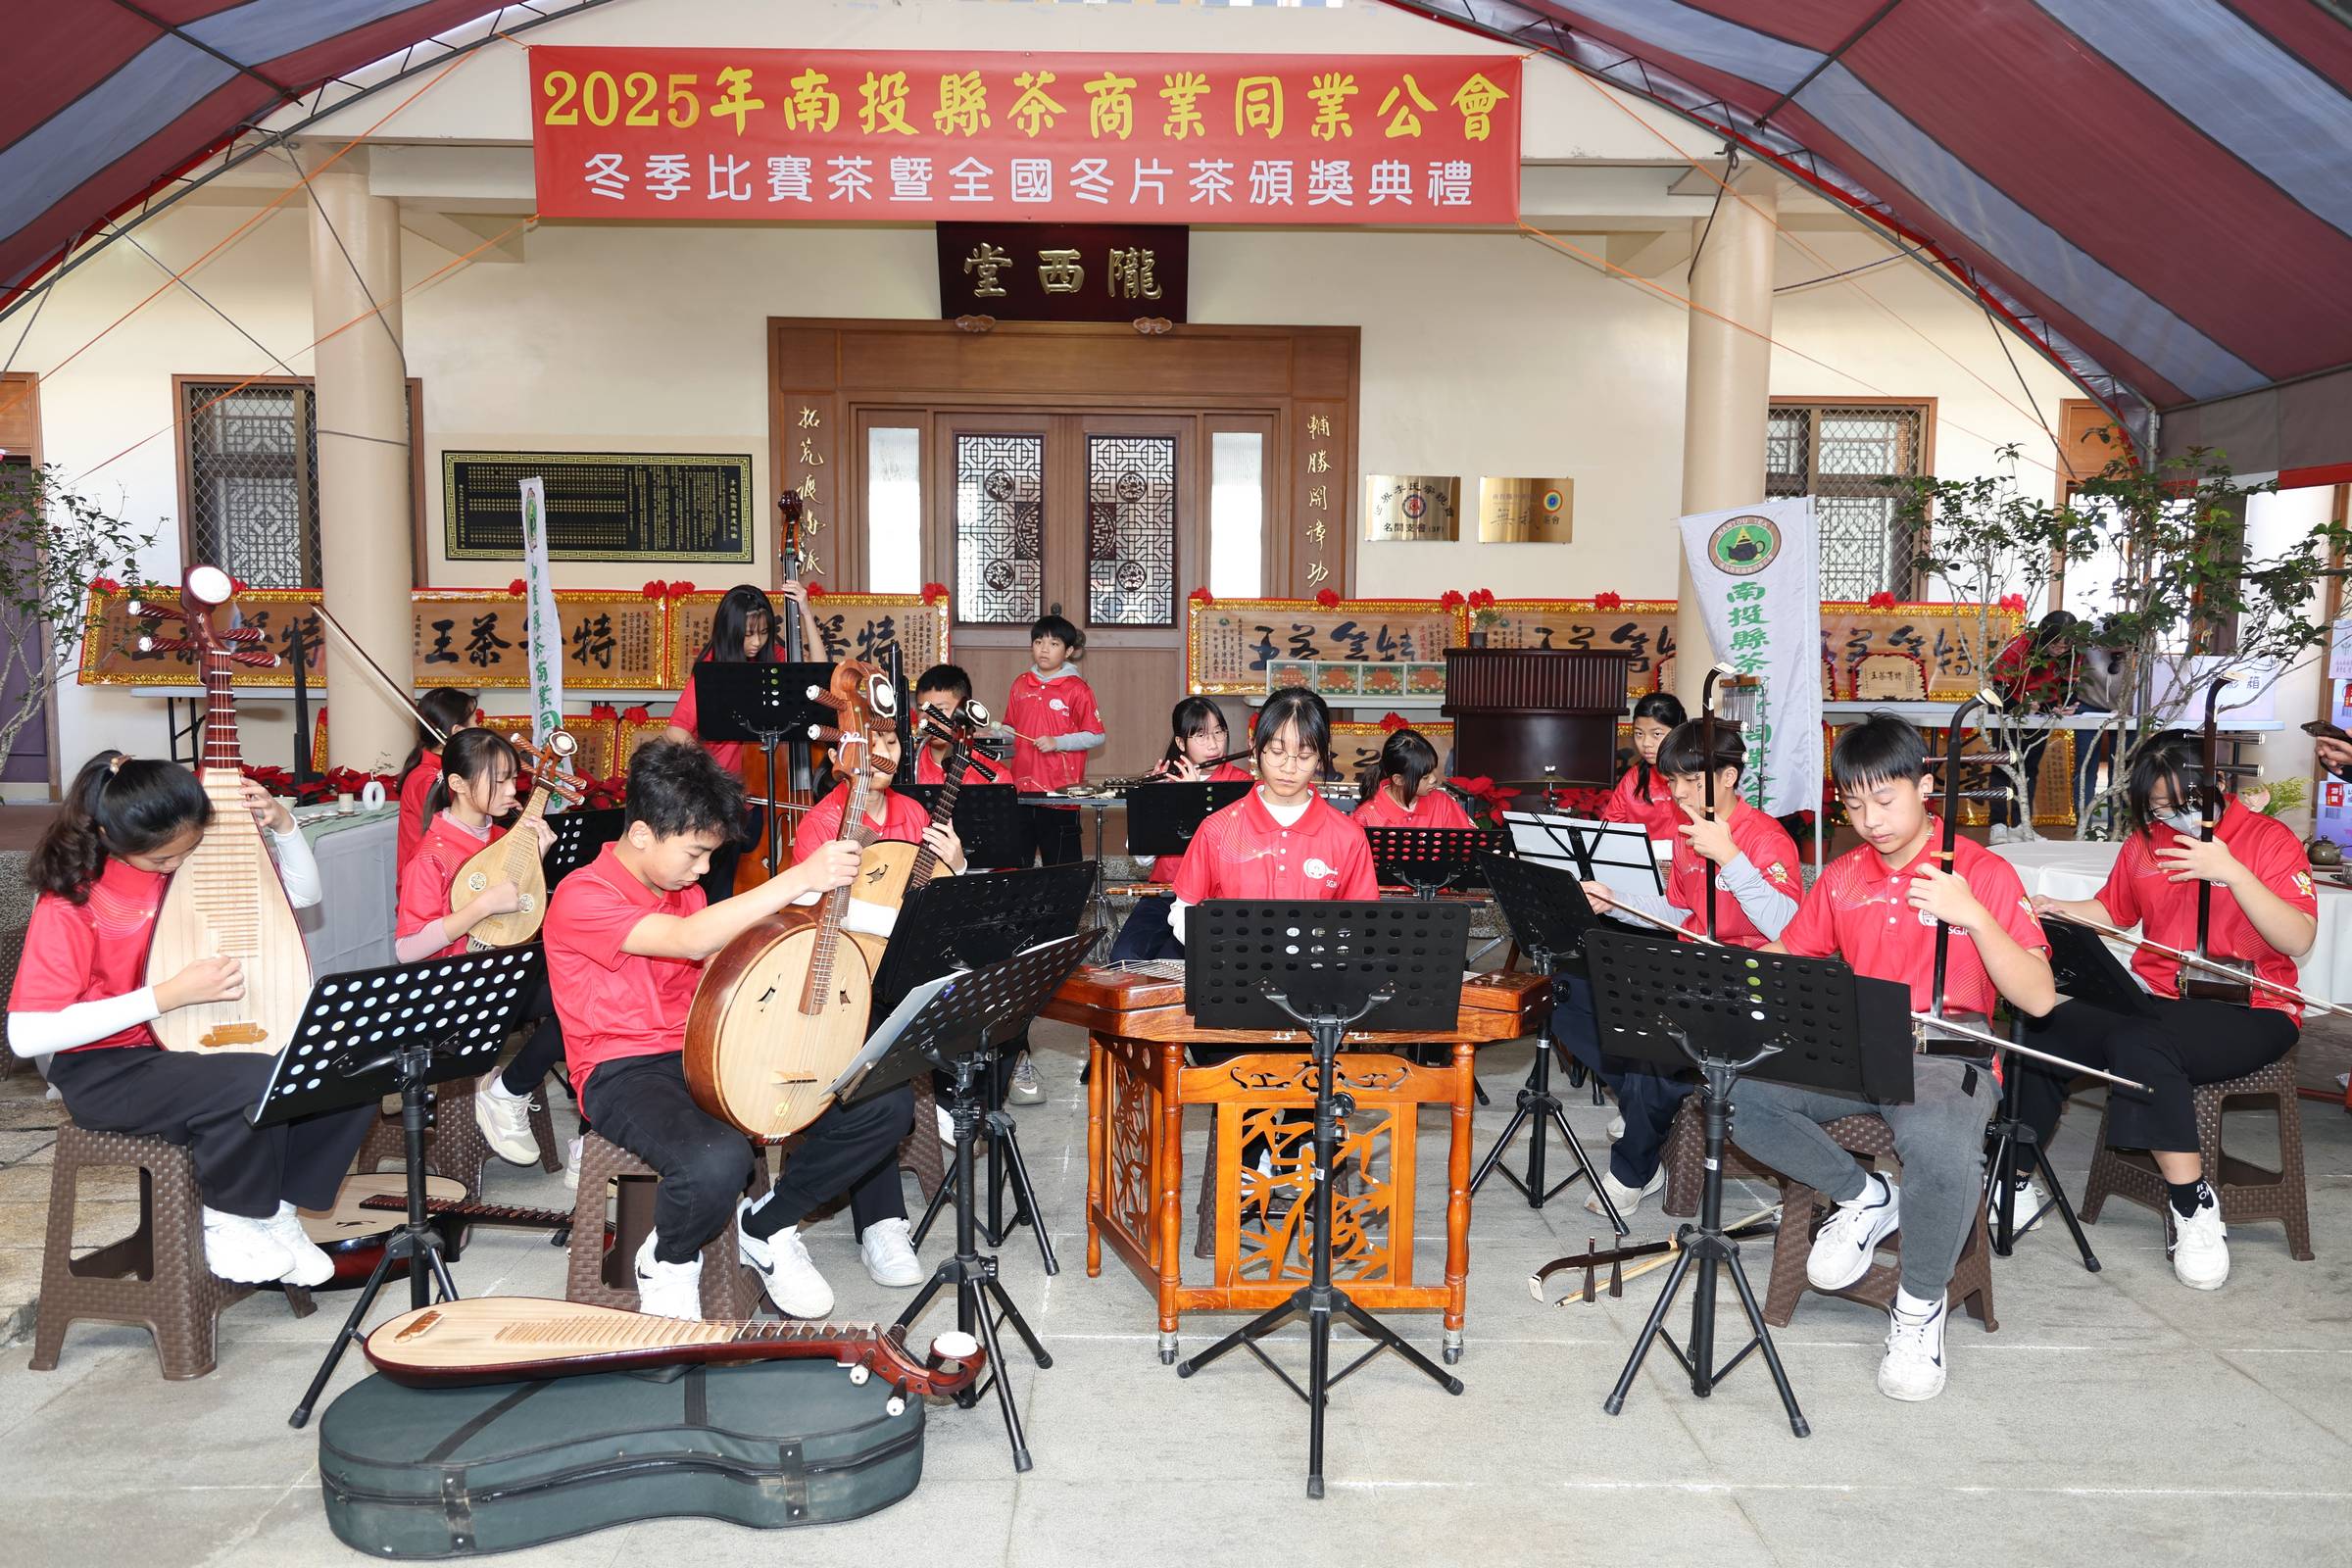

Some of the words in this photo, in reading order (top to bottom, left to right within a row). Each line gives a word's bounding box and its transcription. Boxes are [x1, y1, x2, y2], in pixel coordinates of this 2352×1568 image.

[544, 67, 1510, 142] 2025年南投縣茶商業同業公會
[585, 154, 1472, 206] 冬季比賽茶暨全國冬片茶頒獎典禮
[1717, 518, 1748, 537] NANTOU
[424, 612, 617, 670] 特茶王
